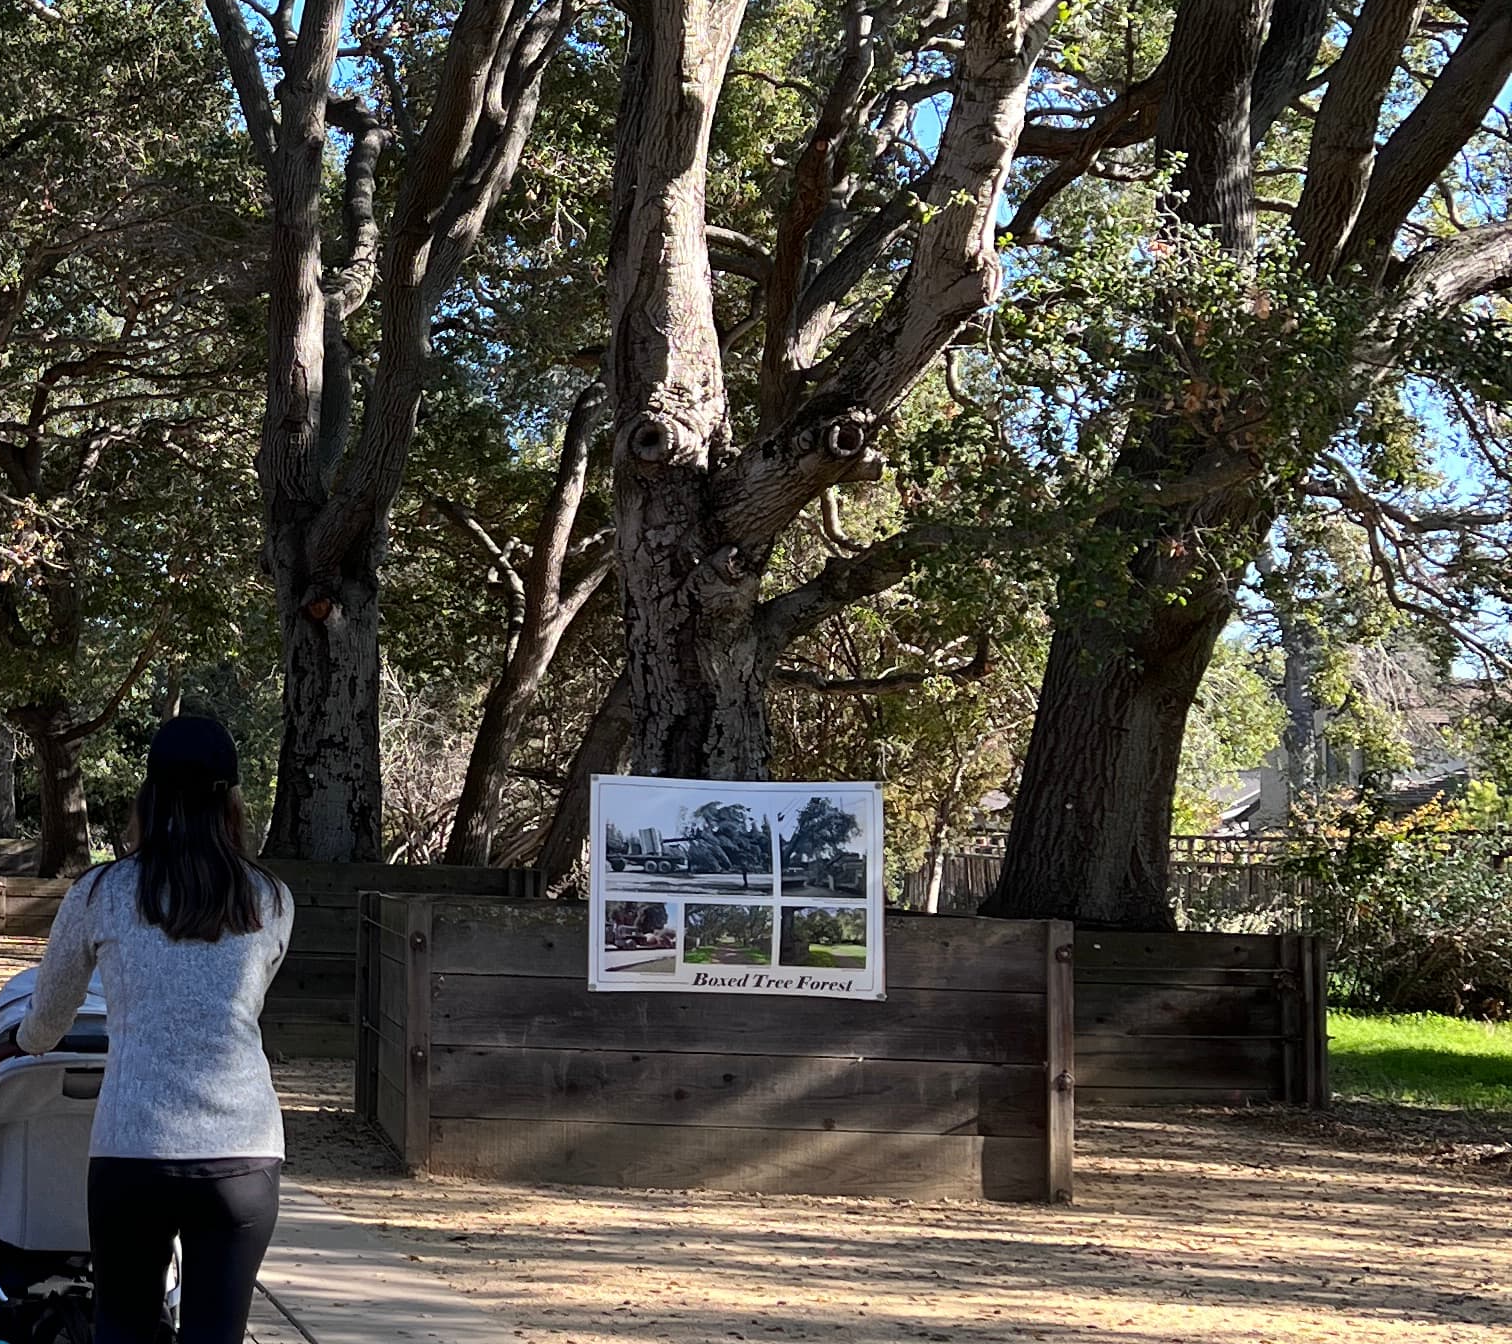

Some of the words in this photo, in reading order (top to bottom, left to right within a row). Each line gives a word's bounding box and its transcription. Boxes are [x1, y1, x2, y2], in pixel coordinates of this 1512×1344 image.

[692, 972, 749, 987] Boxed
[752, 974, 793, 989] Tree
[796, 975, 853, 992] Forest
